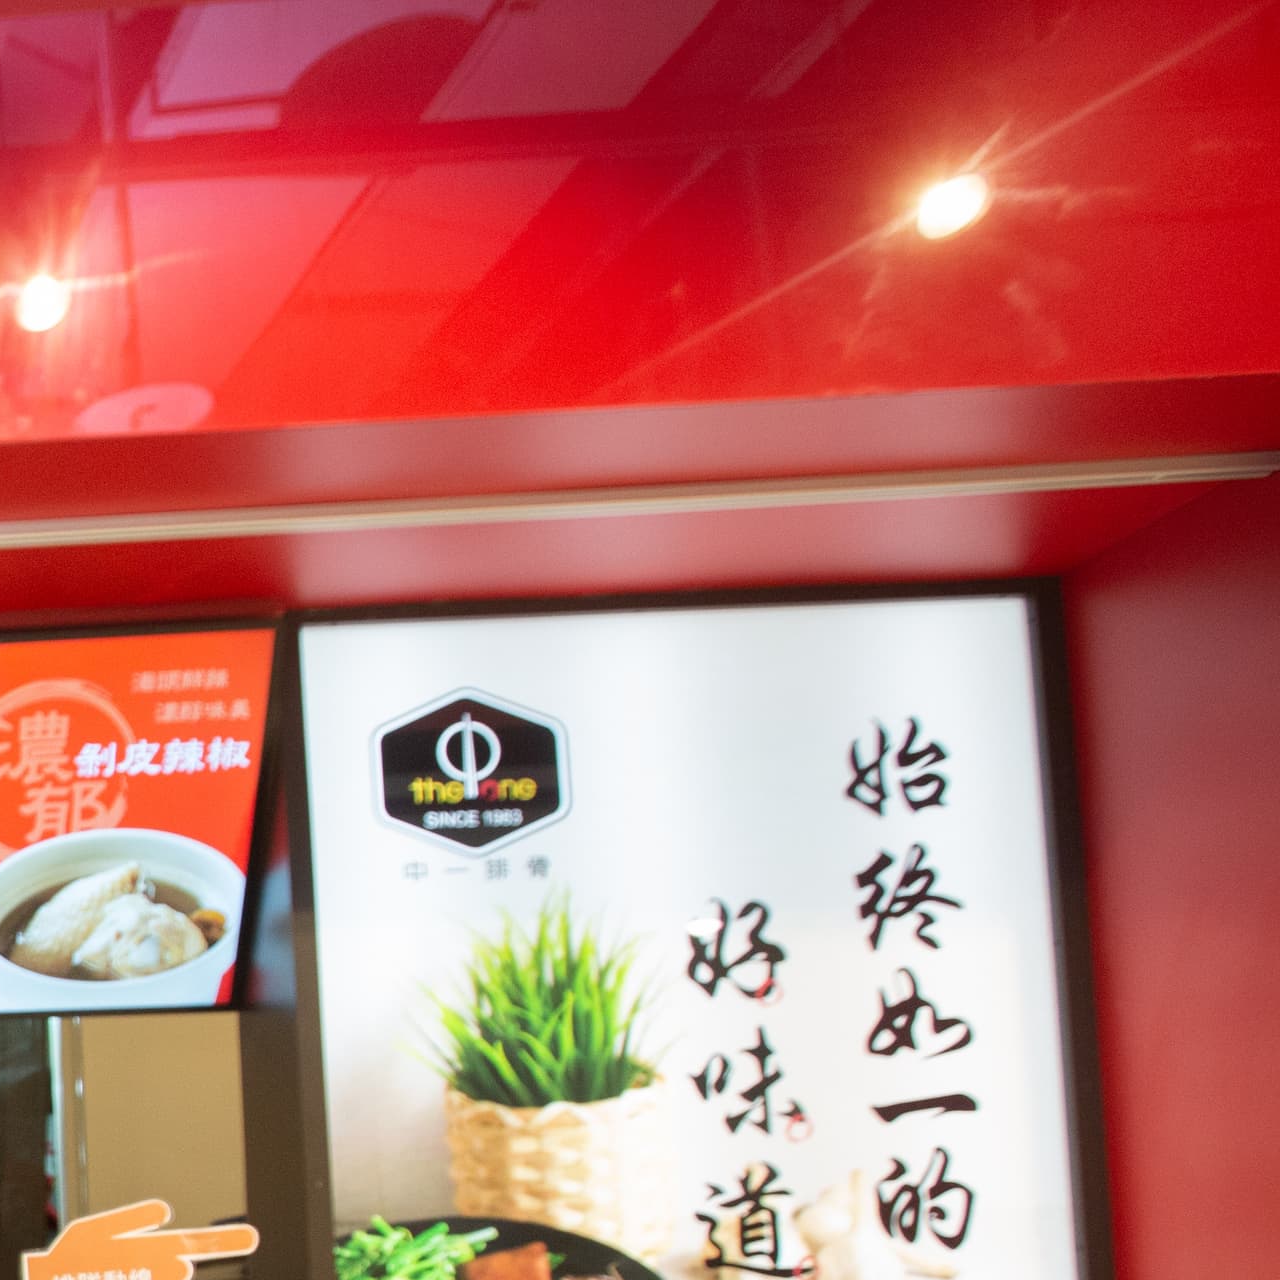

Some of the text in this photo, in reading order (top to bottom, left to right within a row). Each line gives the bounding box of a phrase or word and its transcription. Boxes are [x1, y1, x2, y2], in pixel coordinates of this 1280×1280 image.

[408, 777, 465, 804] the
[423, 811, 481, 829] SINCE
[846, 716, 977, 1250] 始終如一的
[687, 898, 814, 1280] 好味道
